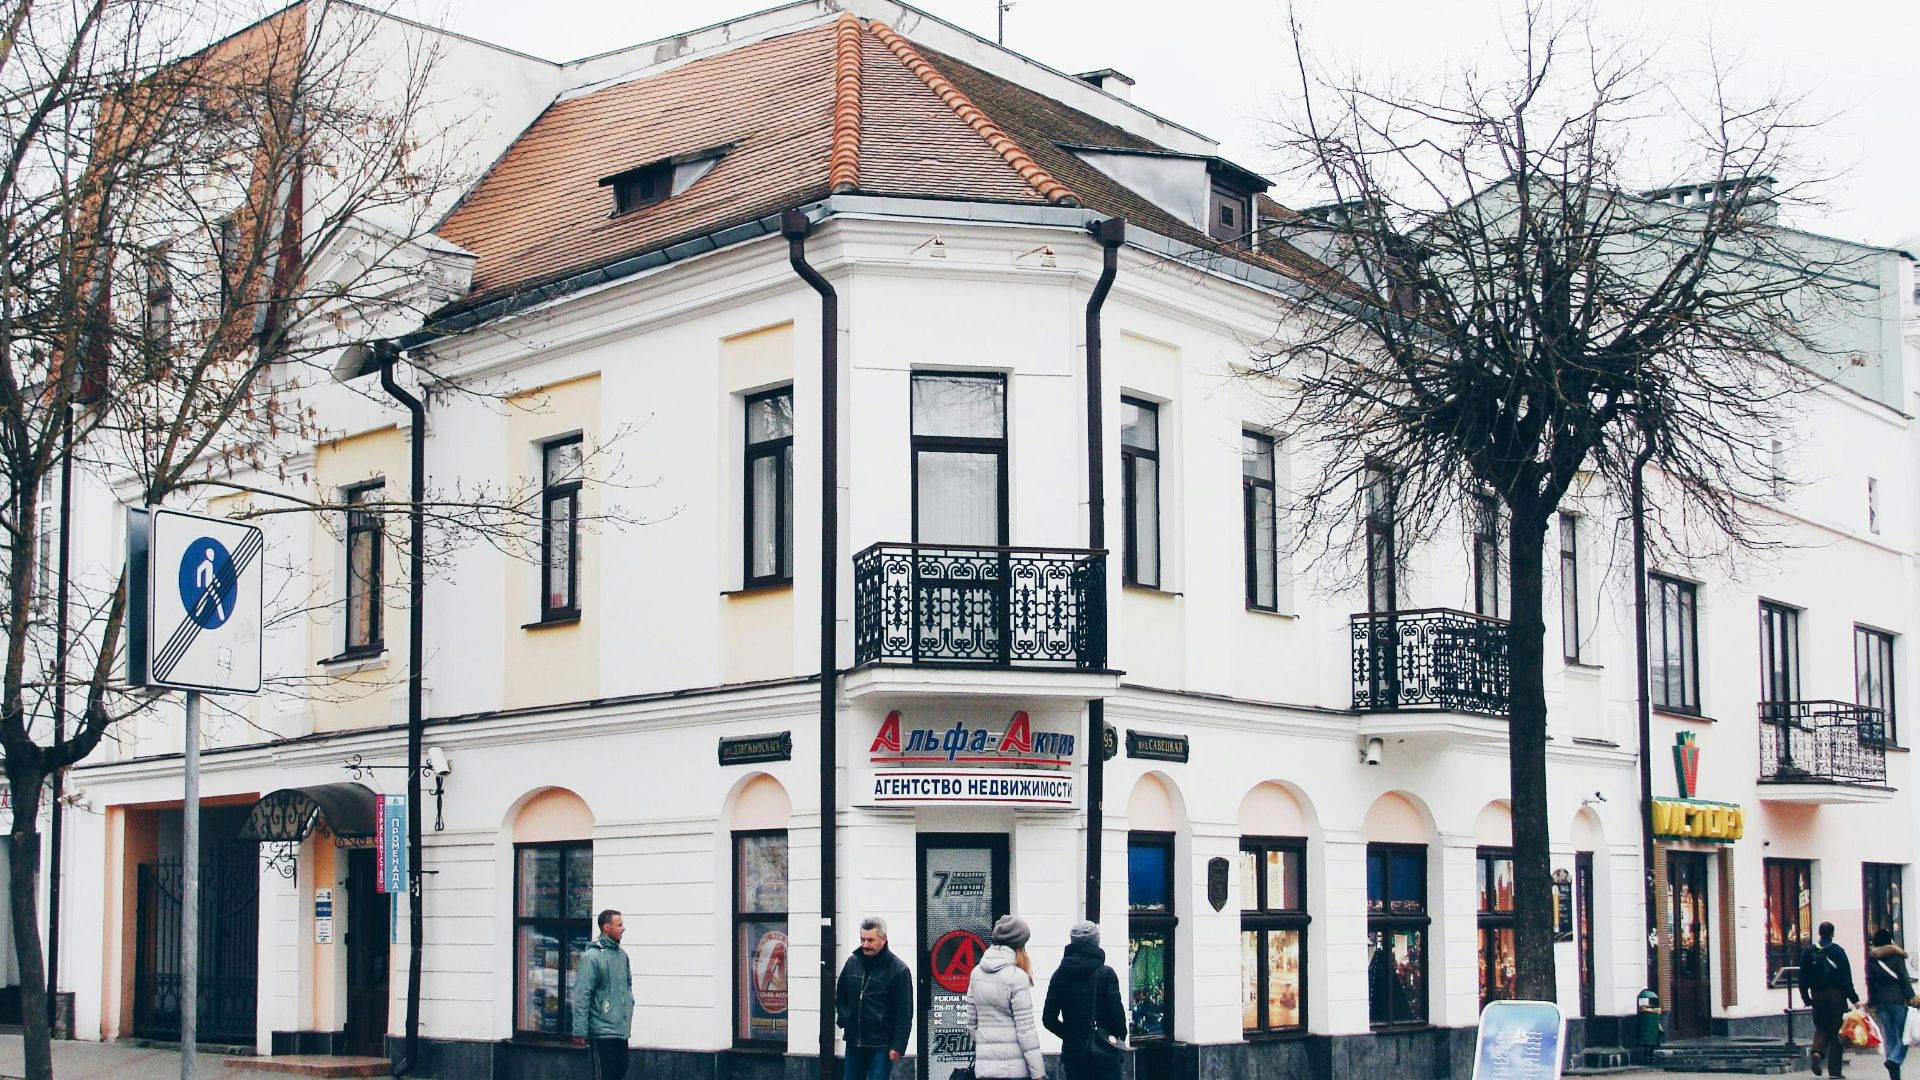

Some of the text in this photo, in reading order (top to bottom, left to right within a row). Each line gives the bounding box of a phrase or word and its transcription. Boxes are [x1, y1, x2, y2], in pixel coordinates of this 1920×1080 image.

[1103, 733, 1113, 748] 95
[874, 778, 1073, 799] АГЕНТСТВО НЕДВИЖИМОСТИ
[391, 818, 400, 890] ПРОМЕНАДА
[932, 871, 951, 898] 7
